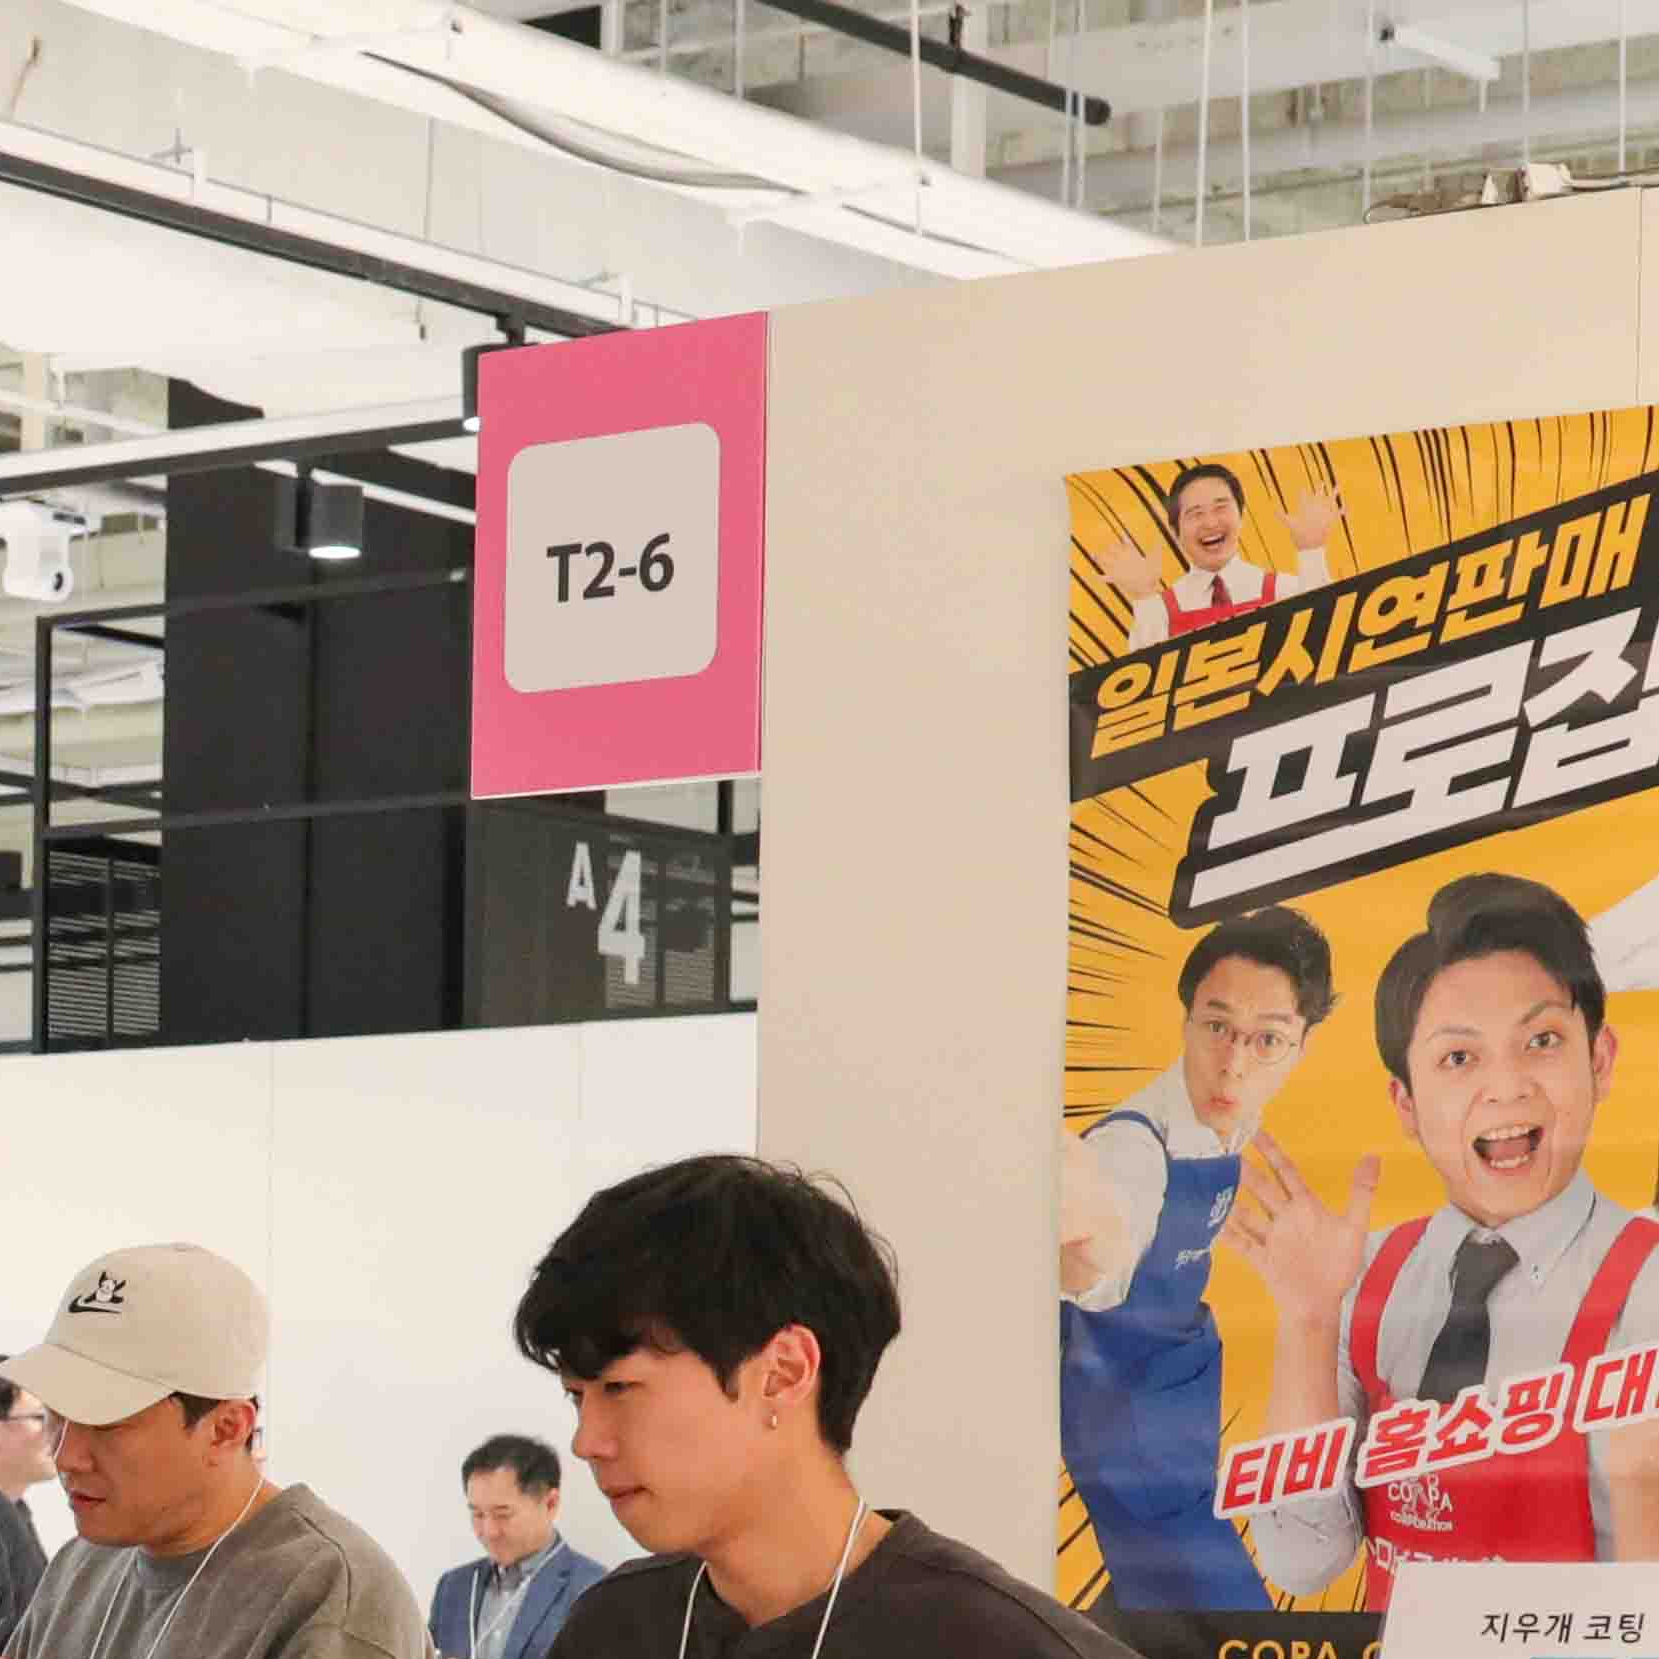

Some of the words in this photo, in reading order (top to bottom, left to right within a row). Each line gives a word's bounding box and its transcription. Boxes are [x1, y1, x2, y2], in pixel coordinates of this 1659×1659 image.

[546, 533, 675, 604] T2-6
[1222, 1425, 1346, 1512] 티비
[1363, 1372, 1561, 1478] 홈쇼핑
[1481, 1612, 1572, 1643] 지우개
[1583, 1611, 1646, 1643] 코팅
